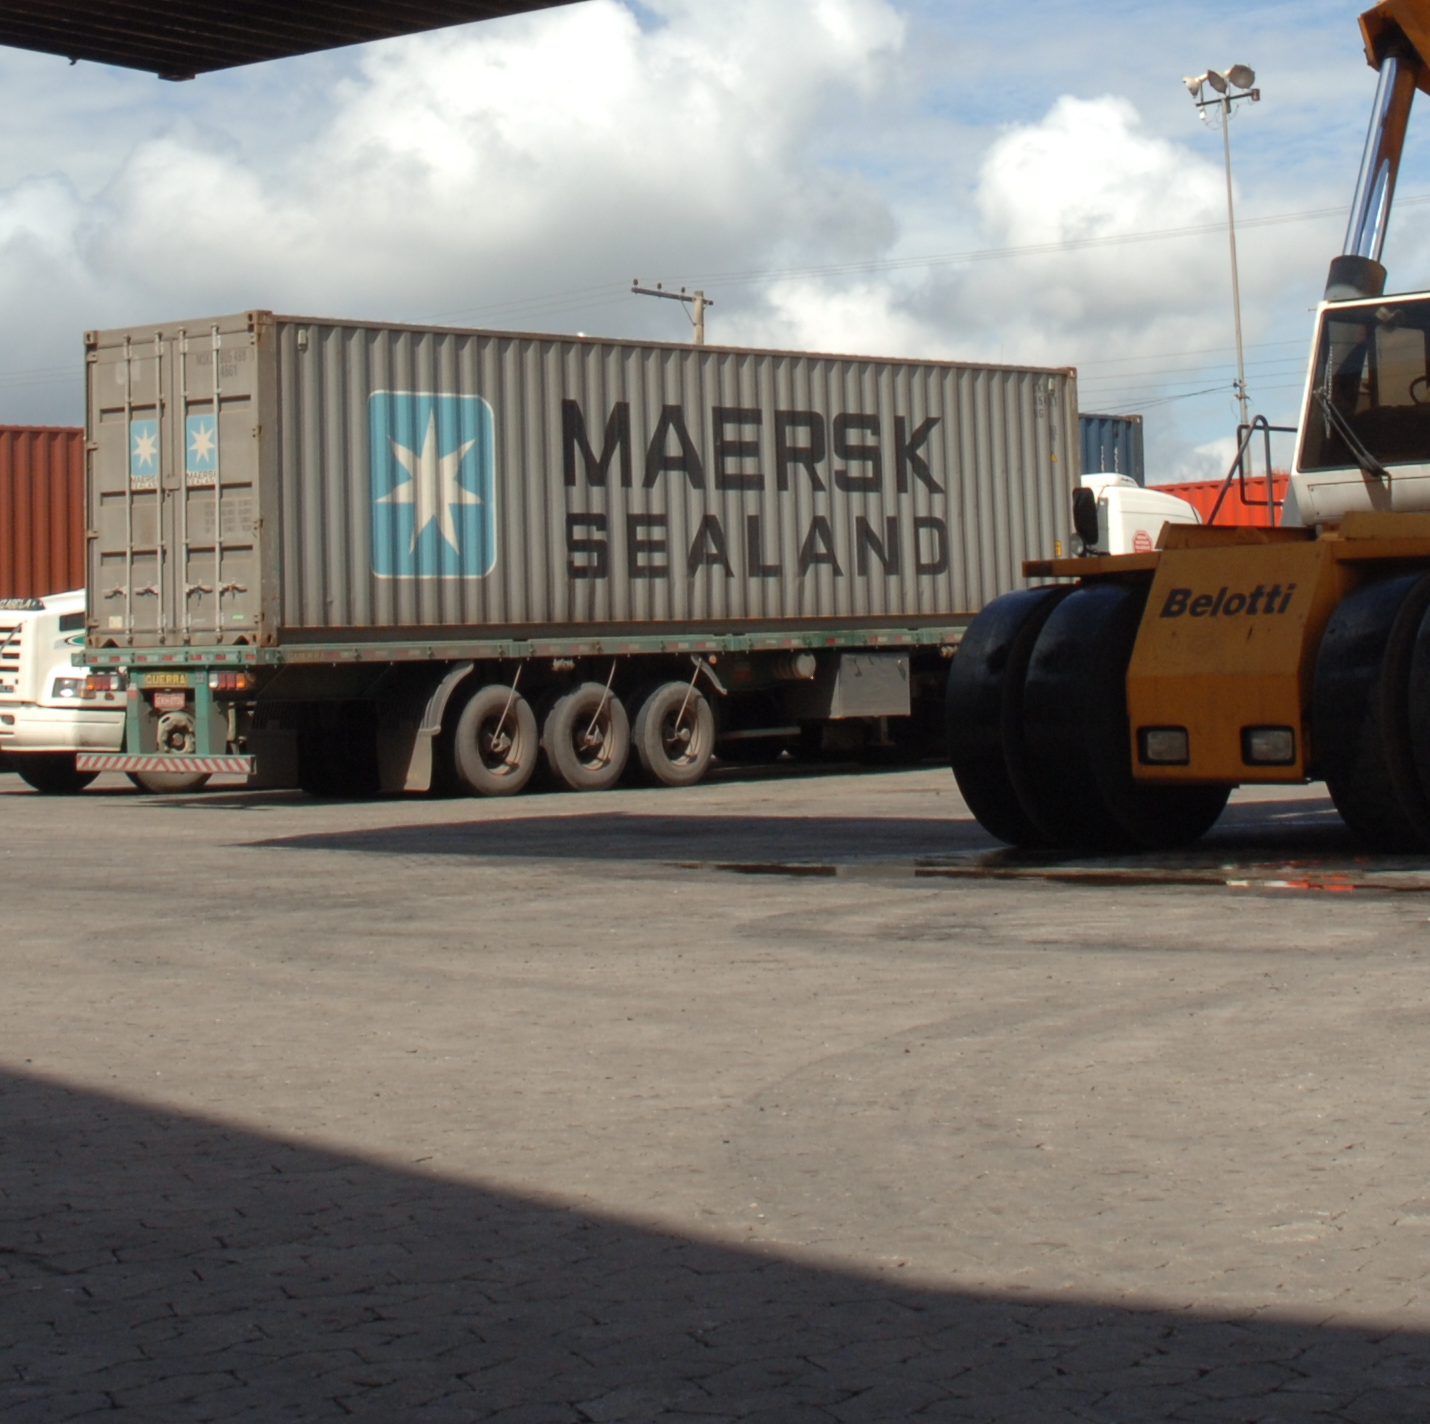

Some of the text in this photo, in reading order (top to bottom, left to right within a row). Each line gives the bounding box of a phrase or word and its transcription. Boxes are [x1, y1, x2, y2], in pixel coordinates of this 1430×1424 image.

[560, 398, 945, 494] MAERSK
[565, 512, 949, 579] SEALAND
[1160, 583, 1296, 618] Belotti
[145, 674, 187, 685] GUERRA
